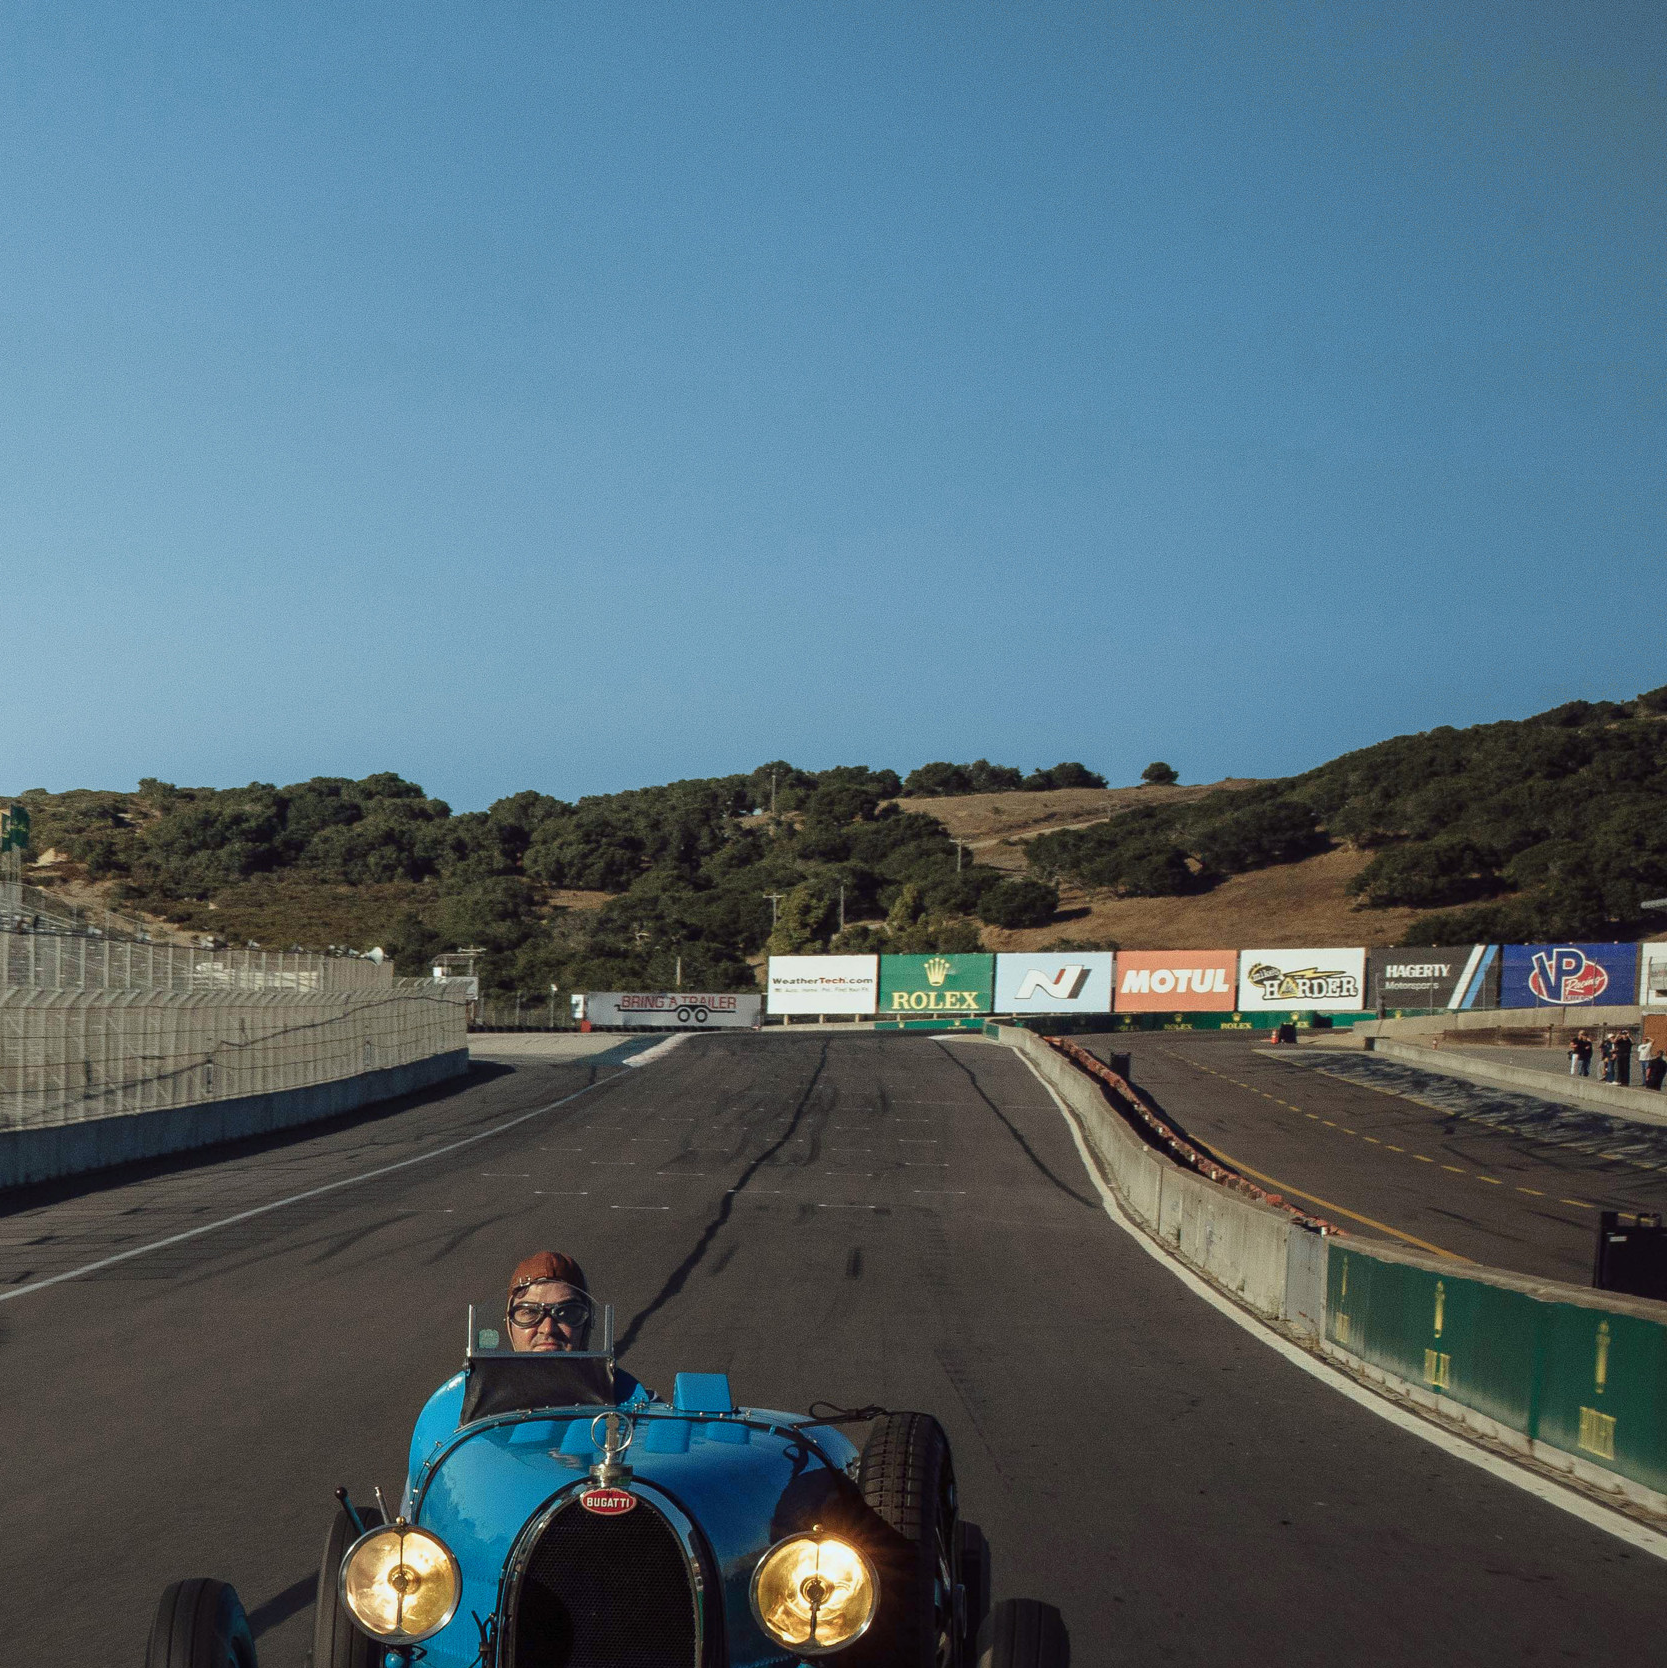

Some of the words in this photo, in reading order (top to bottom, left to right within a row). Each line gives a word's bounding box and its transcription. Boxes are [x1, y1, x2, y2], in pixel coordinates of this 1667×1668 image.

[1386, 964, 1451, 978] HAGERTY
[1531, 948, 1586, 1002] VP
[772, 977, 873, 985] WeatherTech.com
[1120, 969, 1230, 994] MOTUL
[1262, 976, 1359, 1000] HARDER
[1385, 981, 1440, 991] Motorspors
[1565, 975, 1606, 995] Racing
[621, 995, 666, 1009] BRING
[668, 995, 678, 1008] A
[681, 996, 737, 1009] TRAILER
[891, 992, 980, 1010] ROLEX
[1220, 1022, 1253, 1030] ROLEX
[586, 1497, 630, 1508] BUGATTI
